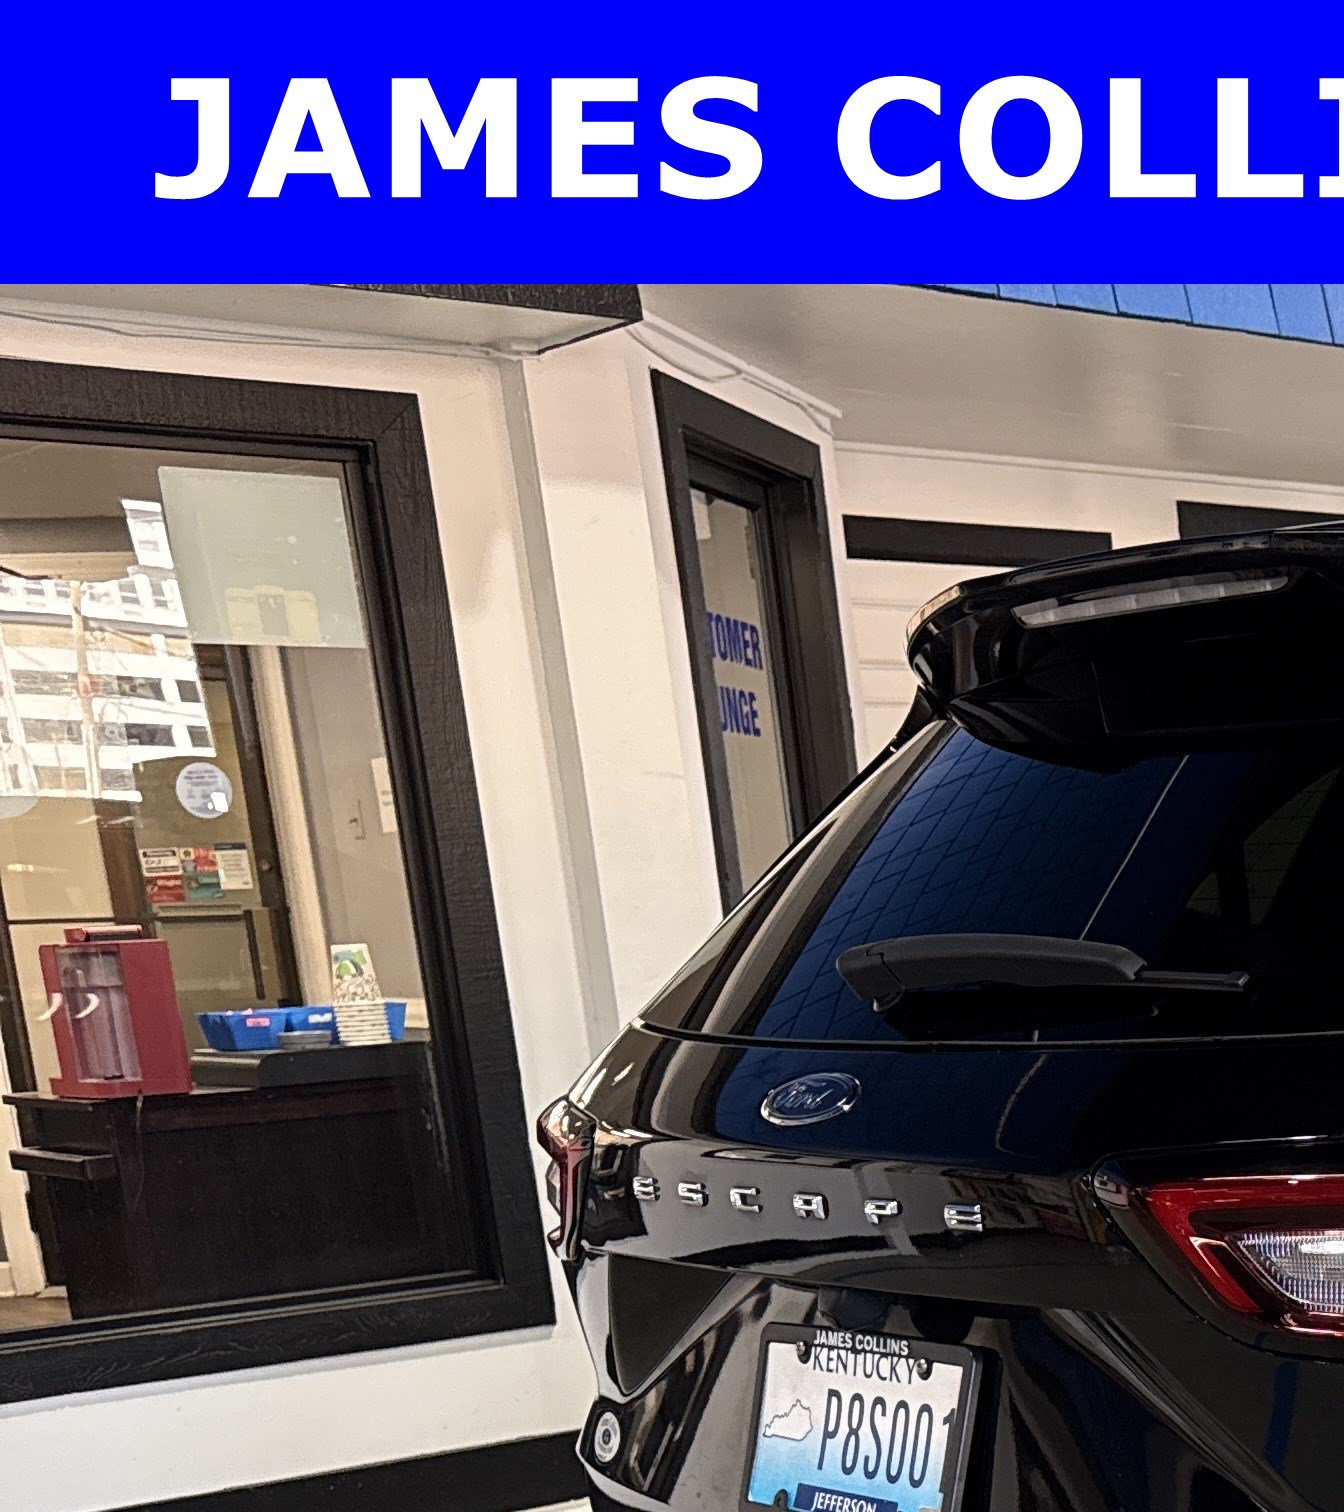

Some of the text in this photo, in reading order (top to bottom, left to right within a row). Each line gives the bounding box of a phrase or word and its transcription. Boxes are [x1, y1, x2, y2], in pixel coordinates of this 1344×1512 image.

[633, 1176, 984, 1232] ESCAPE
[813, 1329, 909, 1356] JAMES COLLINS
[812, 1346, 916, 1384] KENTUCKY
